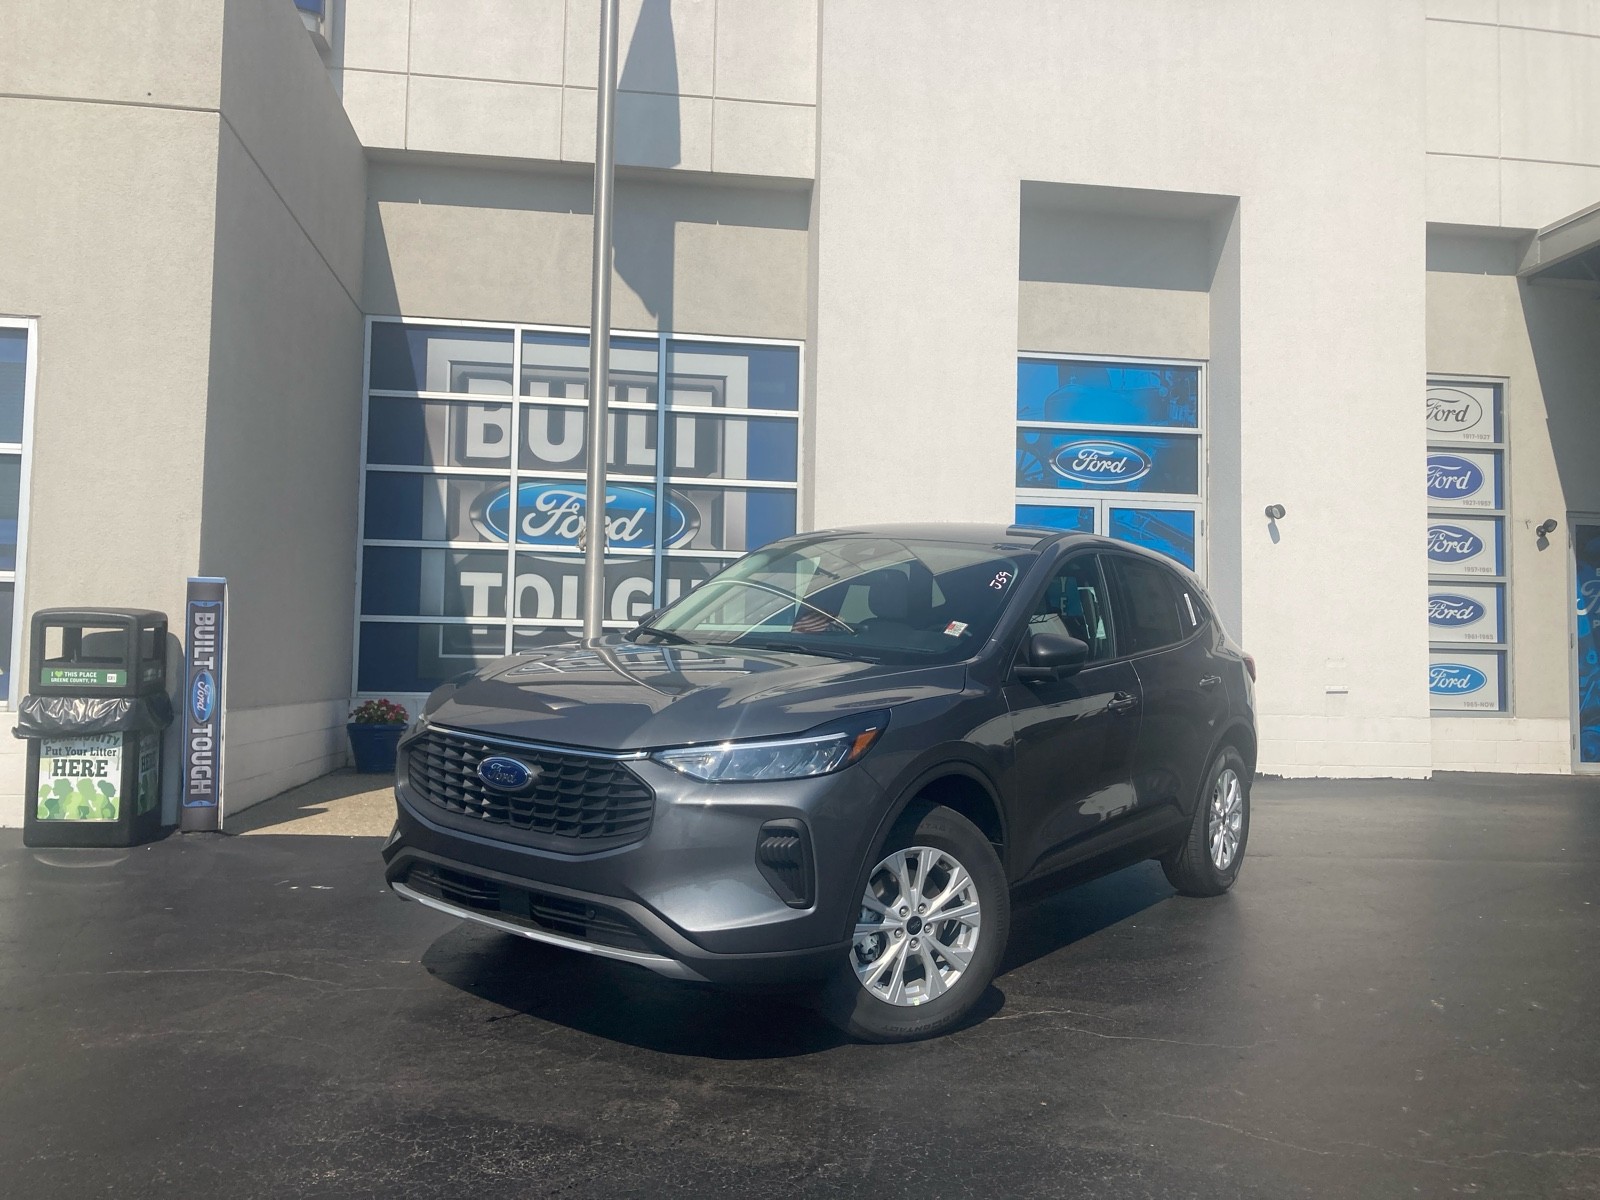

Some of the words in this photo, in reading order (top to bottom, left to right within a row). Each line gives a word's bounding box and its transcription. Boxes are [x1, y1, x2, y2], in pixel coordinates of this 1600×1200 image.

[1072, 448, 1127, 474] Ford
[522, 489, 647, 542] Fod
[460, 571, 704, 638] TOUG
[194, 612, 215, 670] BUILT
[1430, 668, 1471, 688] Ford
[196, 681, 210, 711] Ford
[45, 746, 62, 756] Put
[65, 746, 87, 756] Your
[90, 746, 117, 757] Litter
[190, 724, 212, 795] TOUGH
[52, 759, 108, 777] HERE
[488, 763, 518, 783] Ford
